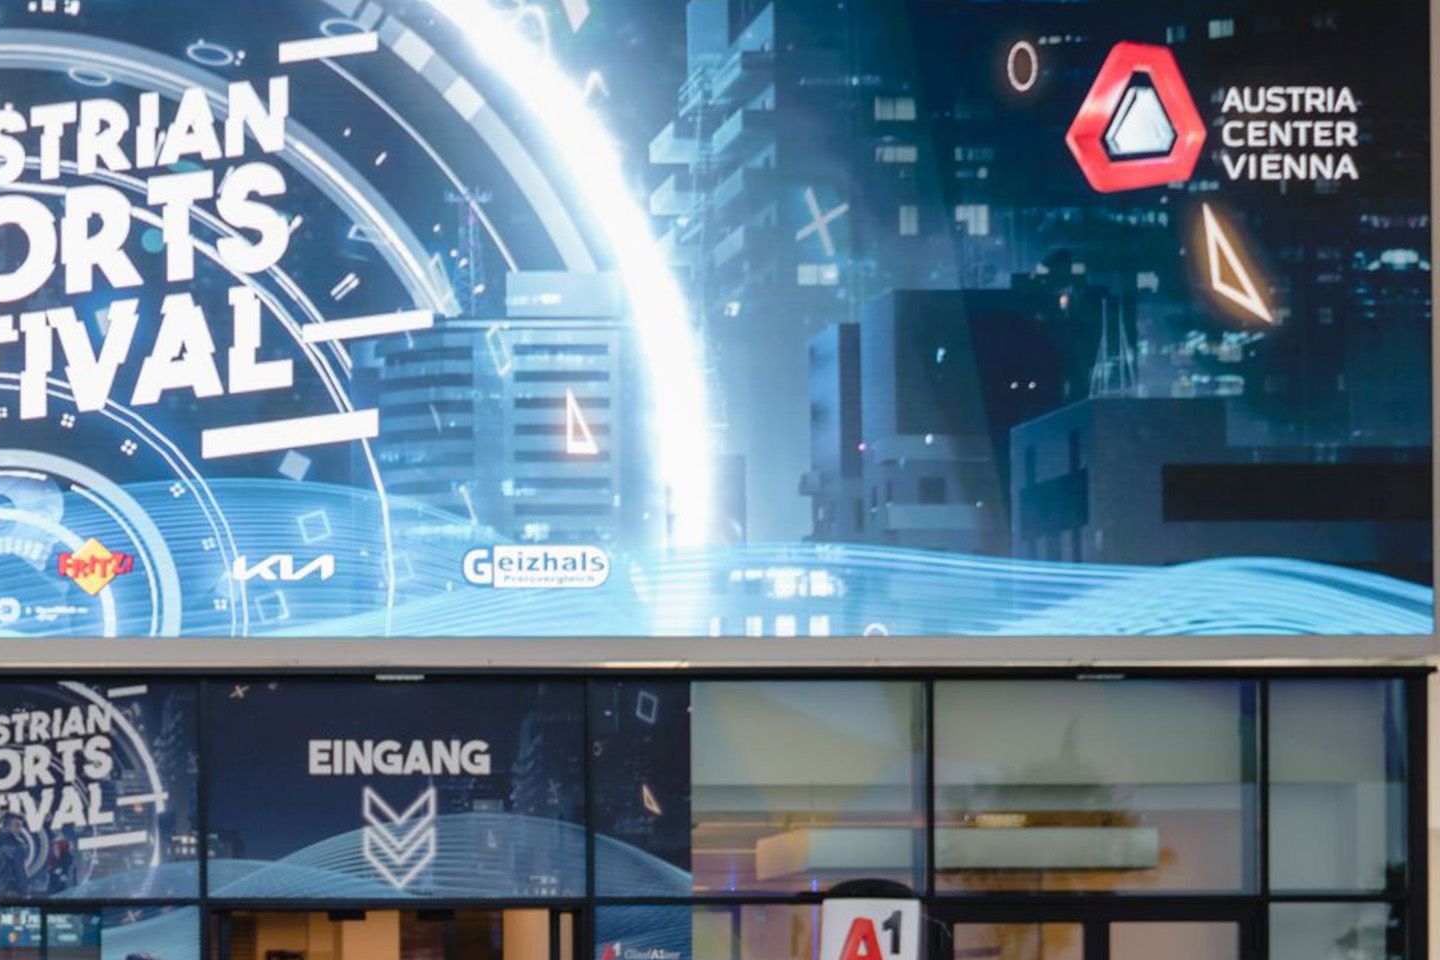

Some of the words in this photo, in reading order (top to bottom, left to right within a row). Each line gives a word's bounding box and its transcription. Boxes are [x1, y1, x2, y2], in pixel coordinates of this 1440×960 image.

[1222, 86, 1357, 114] AUSTRIA
[1222, 119, 1357, 148] CENTER
[1223, 154, 1358, 181] VIENNA
[463, 548, 606, 585] Geizhals
[308, 740, 491, 776] EINGANG
